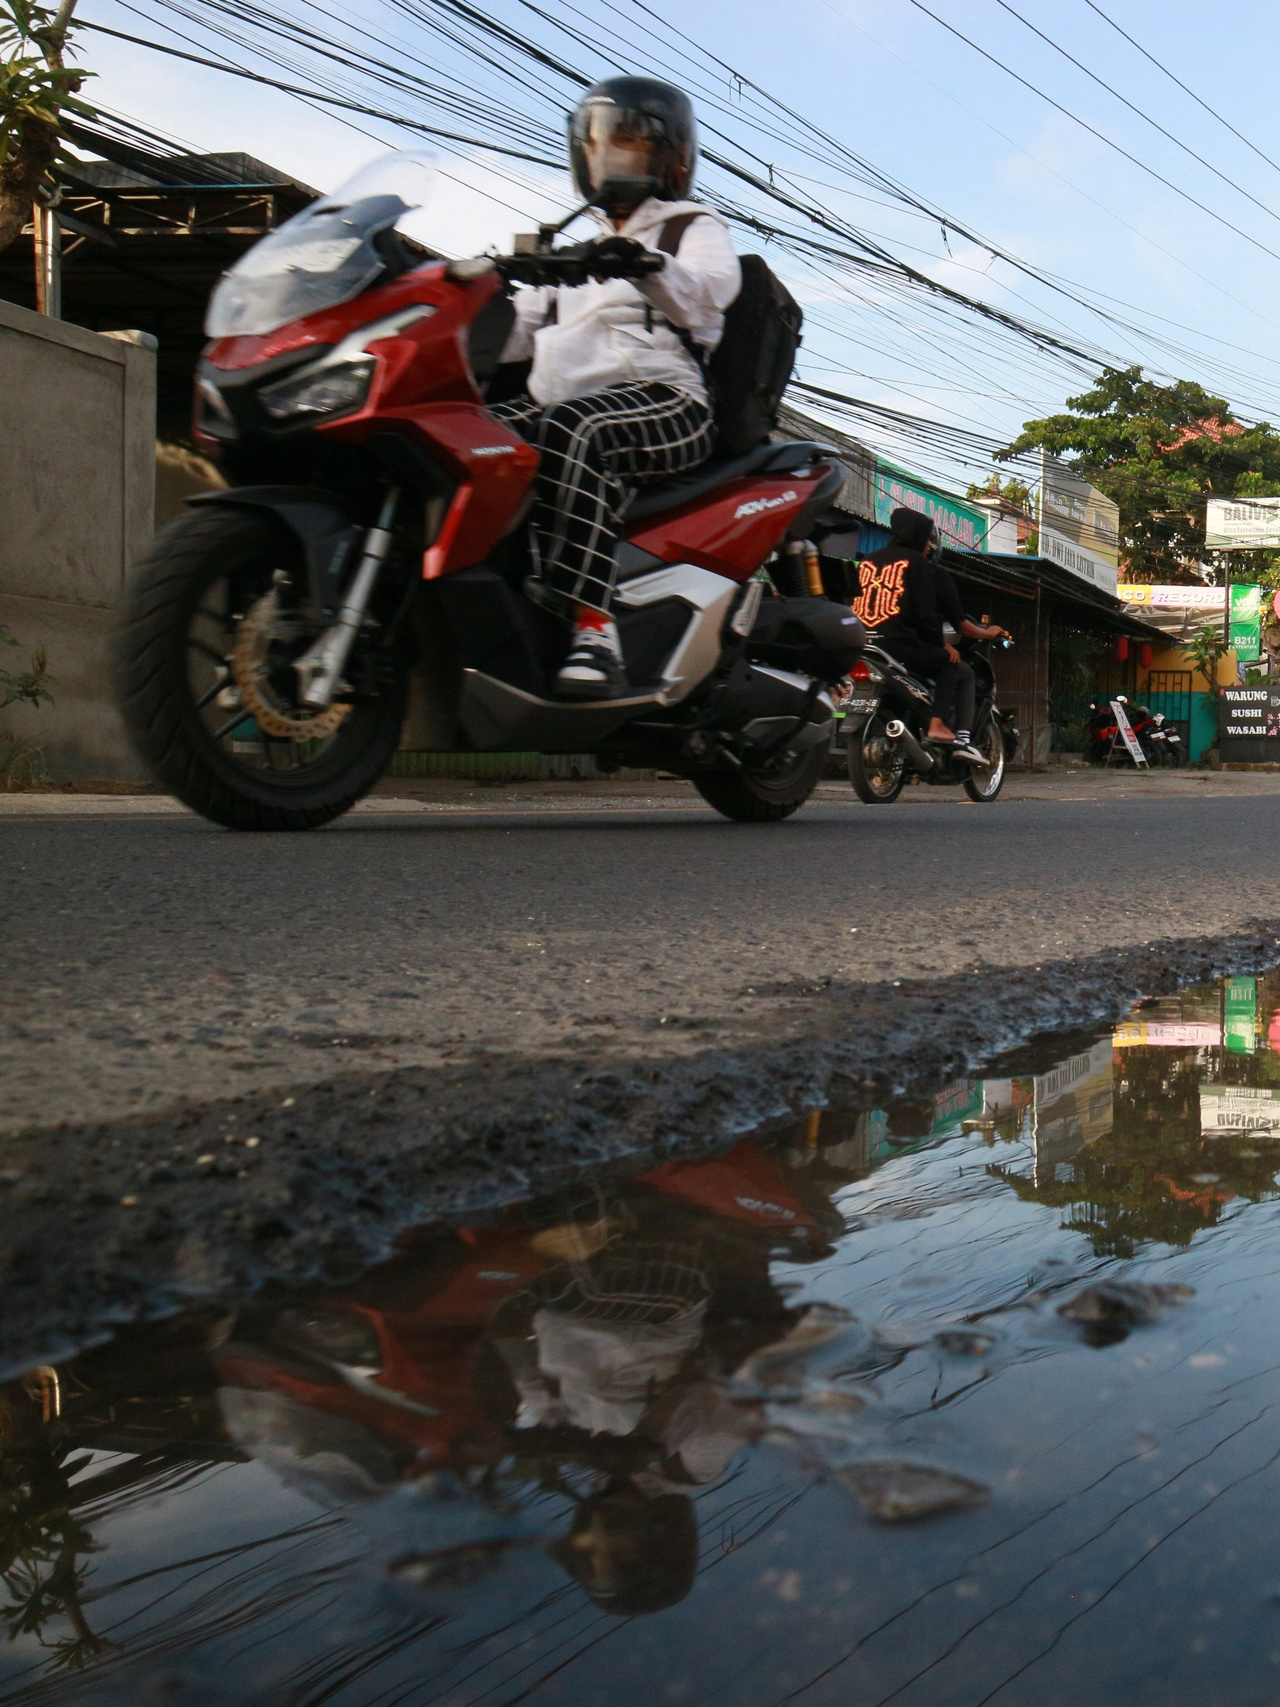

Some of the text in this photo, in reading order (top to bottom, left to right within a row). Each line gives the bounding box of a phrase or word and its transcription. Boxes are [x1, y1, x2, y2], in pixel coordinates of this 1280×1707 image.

[1234, 637, 1256, 645] B211
[1225, 691, 1267, 701] WARUNG
[1231, 709, 1262, 717] SUSHI
[1227, 726, 1266, 735] WASABI
